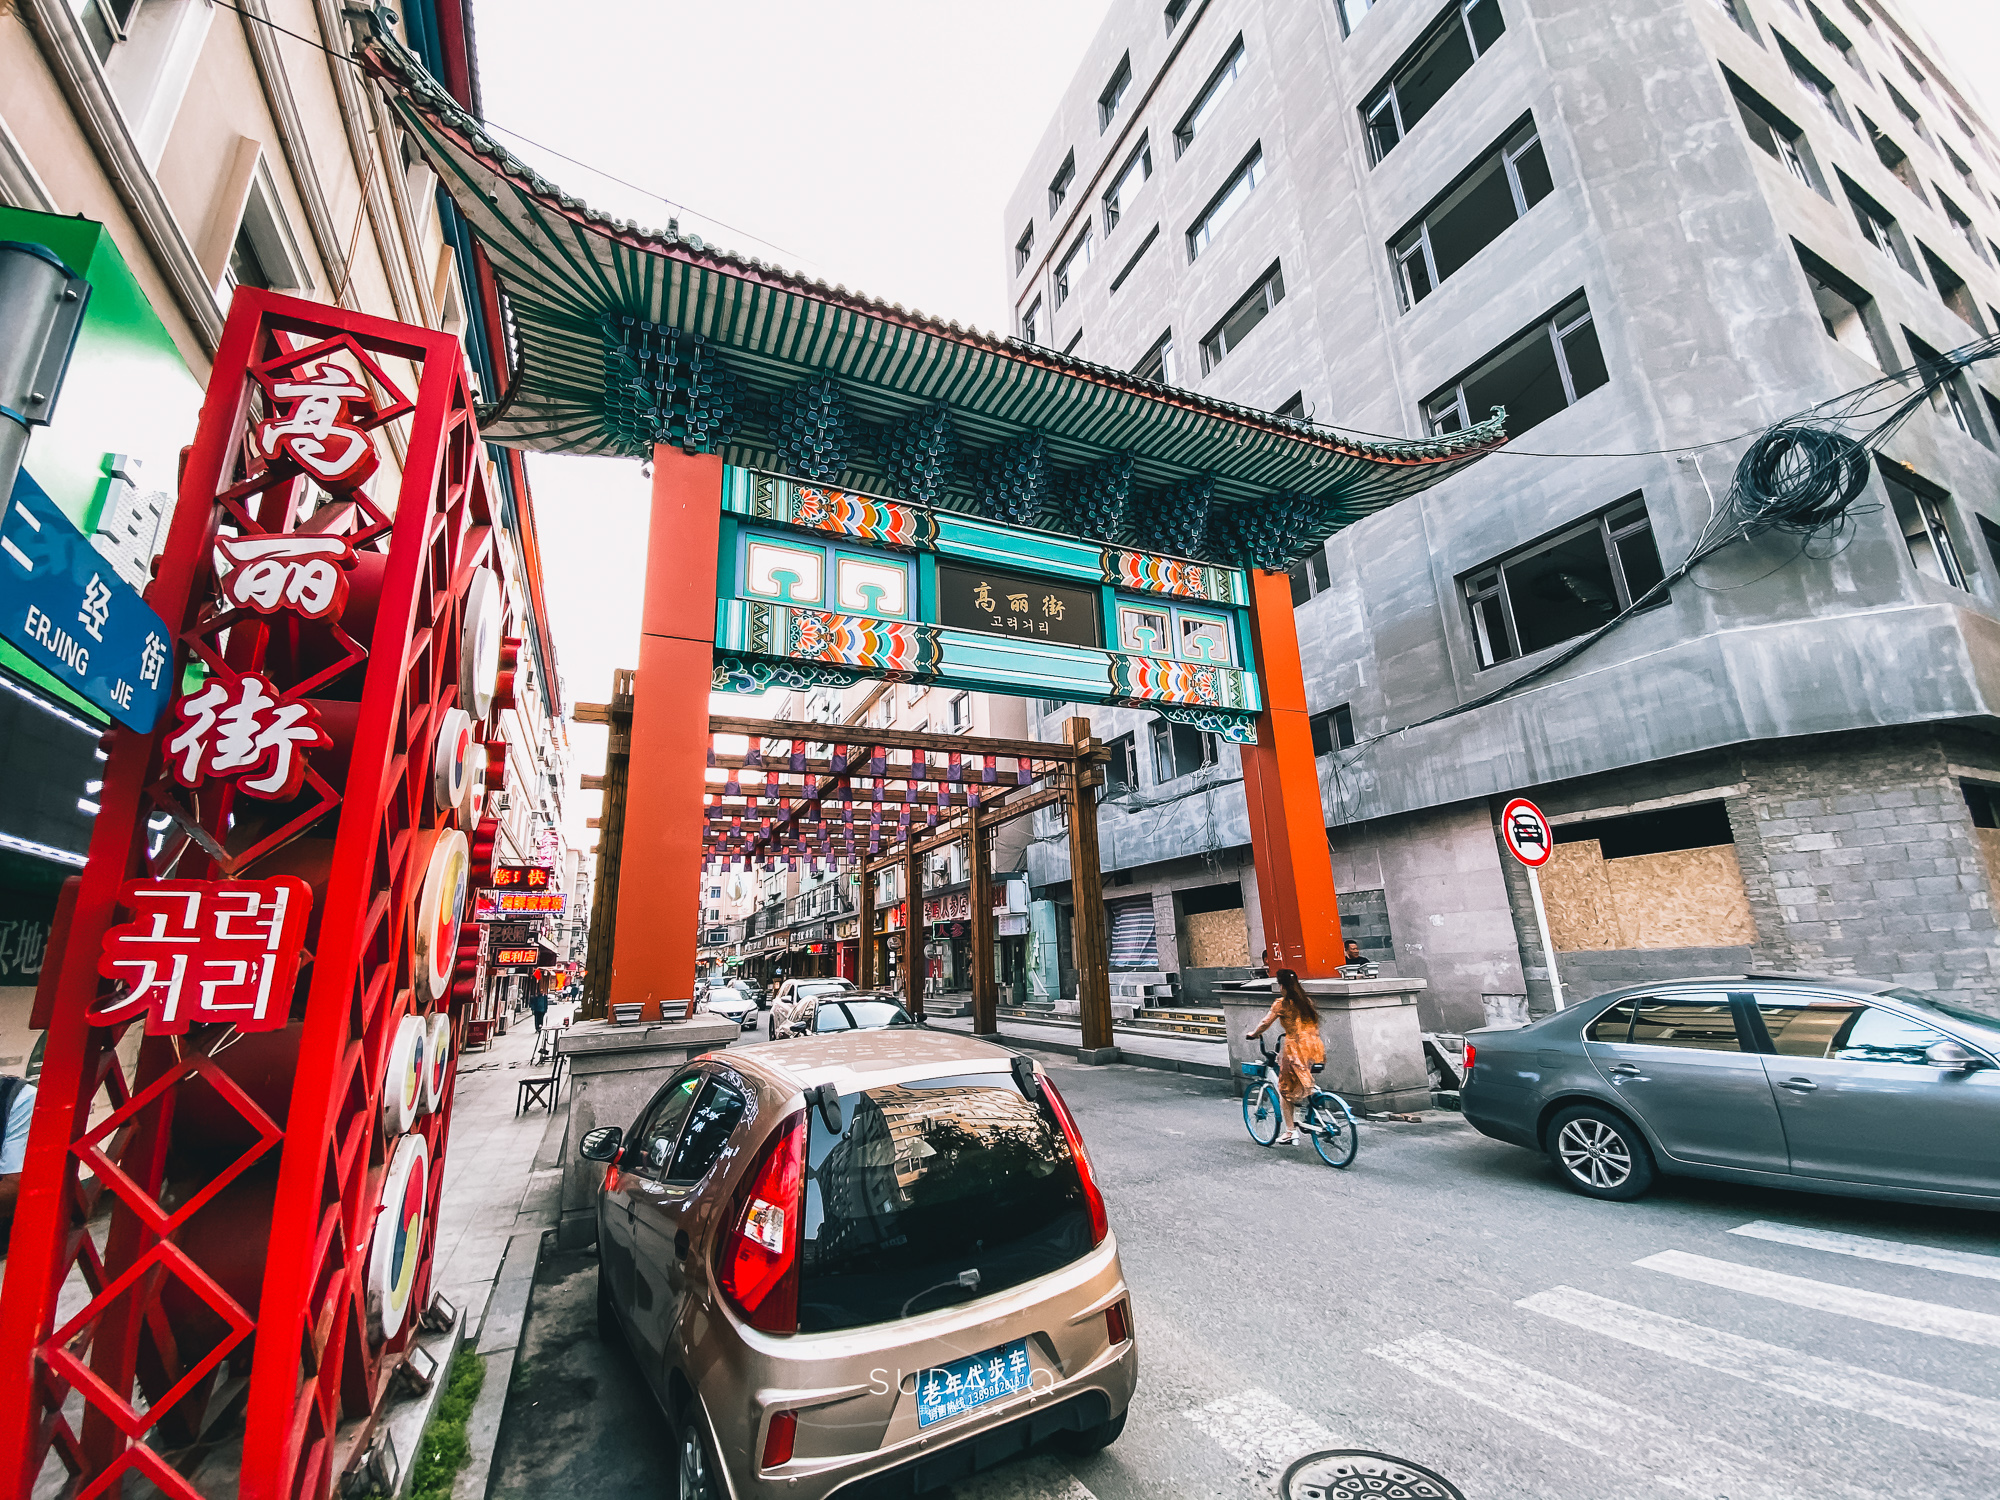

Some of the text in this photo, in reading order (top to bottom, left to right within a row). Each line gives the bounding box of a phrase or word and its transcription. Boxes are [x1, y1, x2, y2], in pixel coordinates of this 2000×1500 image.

[1, 500, 167, 690] 二经街
[973, 581, 1066, 621] 高丽街
[24, 604, 134, 710] ERJING JIE
[119, 886, 290, 950] 고려
[100, 954, 276, 1022] 거리
[498, 950, 537, 963] 便利店
[922, 1350, 1027, 1407] 老年代步车
